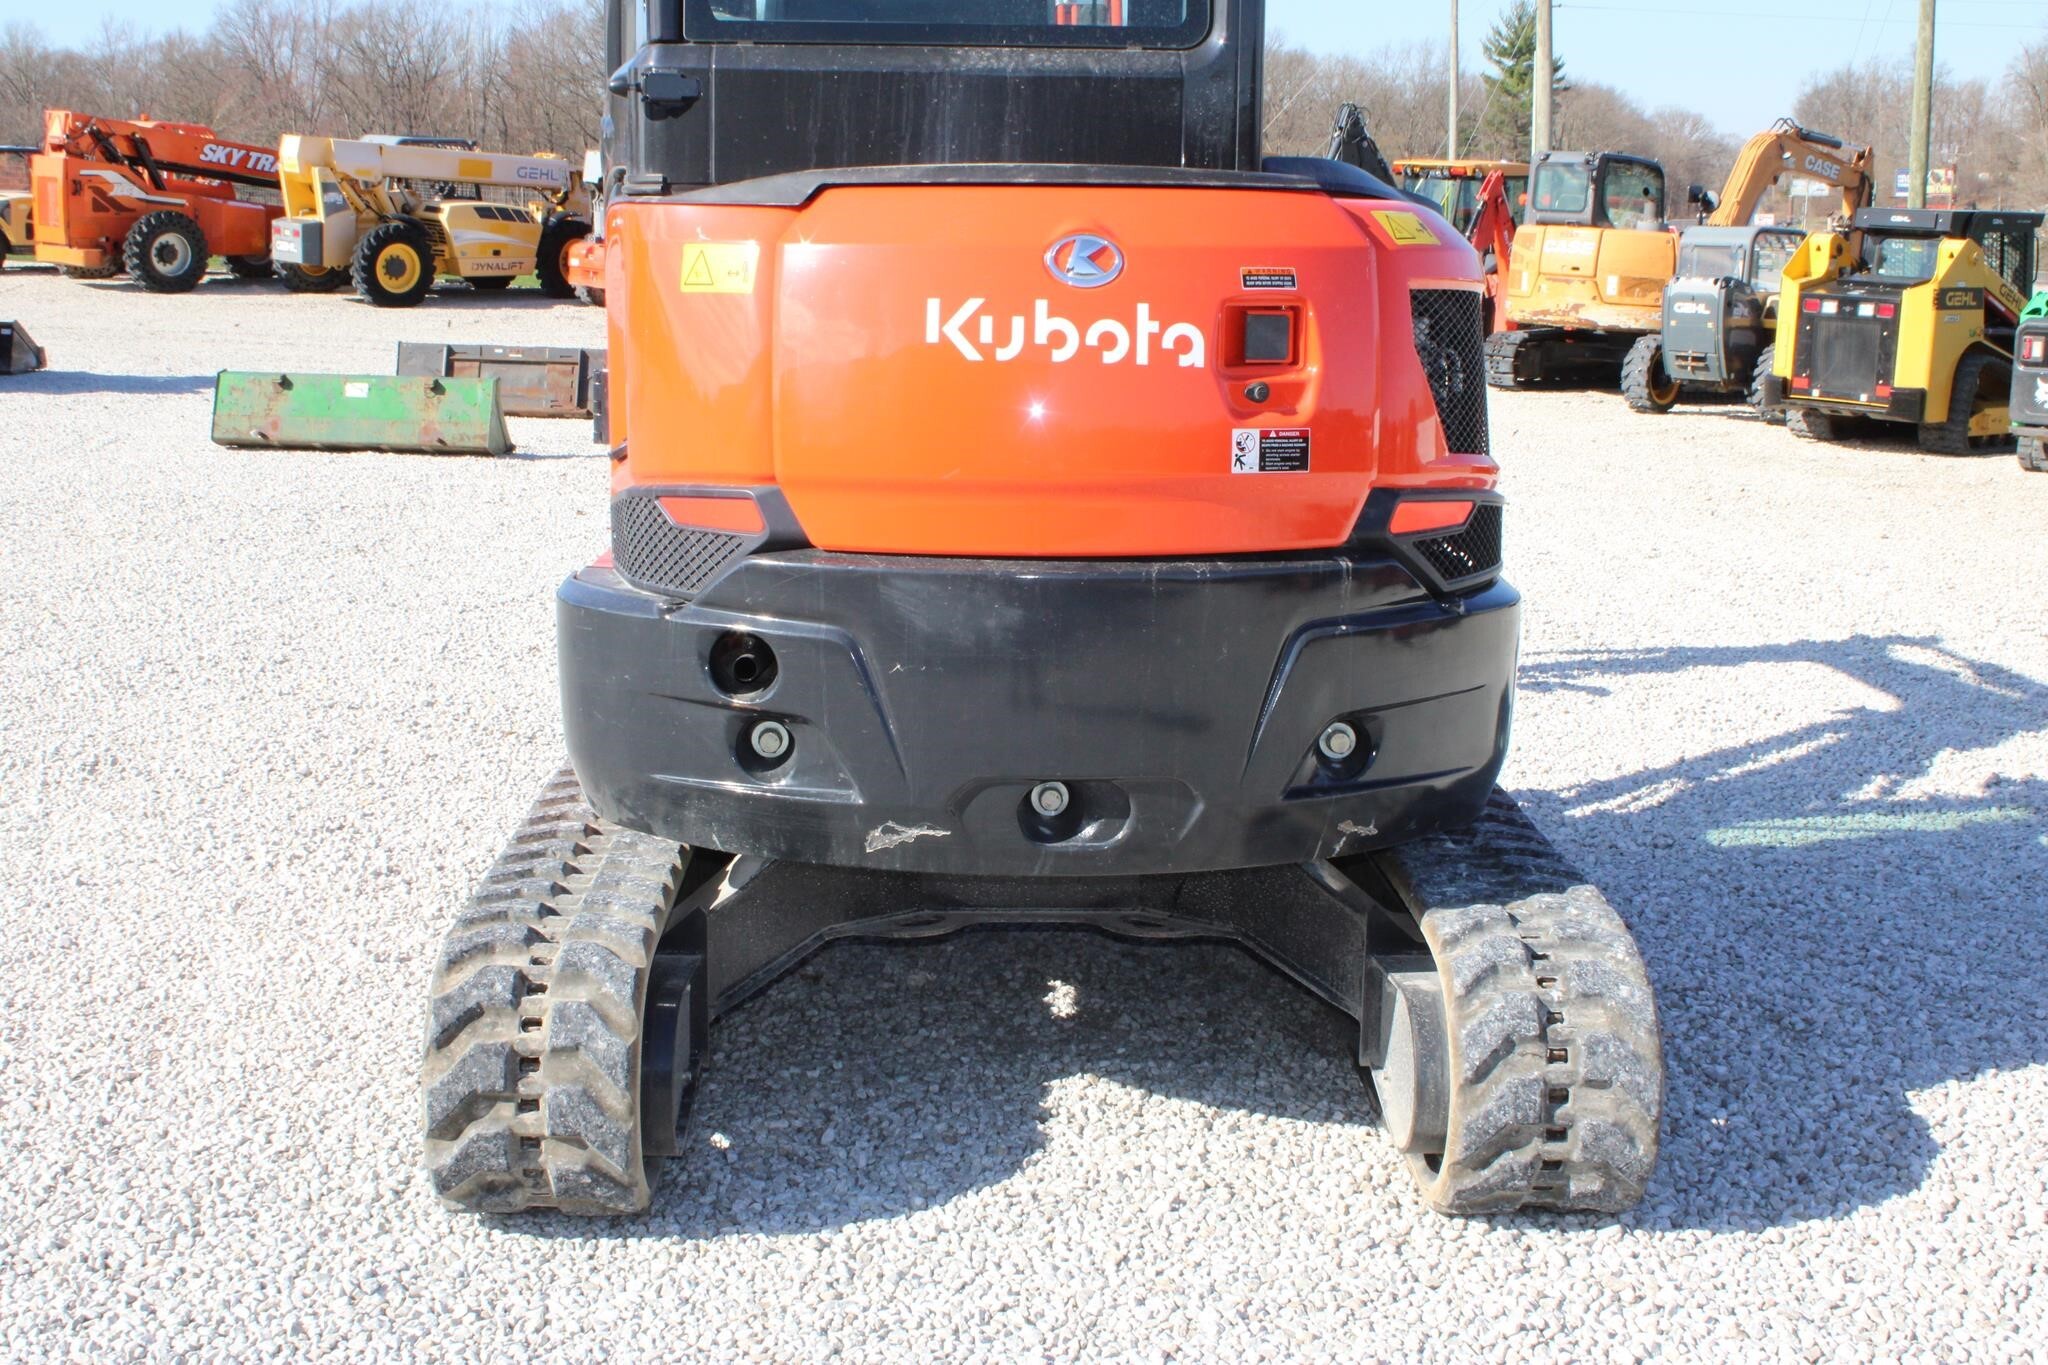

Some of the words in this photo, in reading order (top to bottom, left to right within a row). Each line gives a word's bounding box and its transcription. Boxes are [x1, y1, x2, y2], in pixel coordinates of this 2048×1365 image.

[200, 144, 247, 166] SKY
[516, 166, 560, 180] GEHL
[1805, 155, 1840, 180] CASE
[471, 261, 525, 271] DYNALIFT
[1945, 291, 1977, 307] GEHL
[1673, 302, 1711, 314] GEHL
[926, 297, 1205, 368] Kubota
